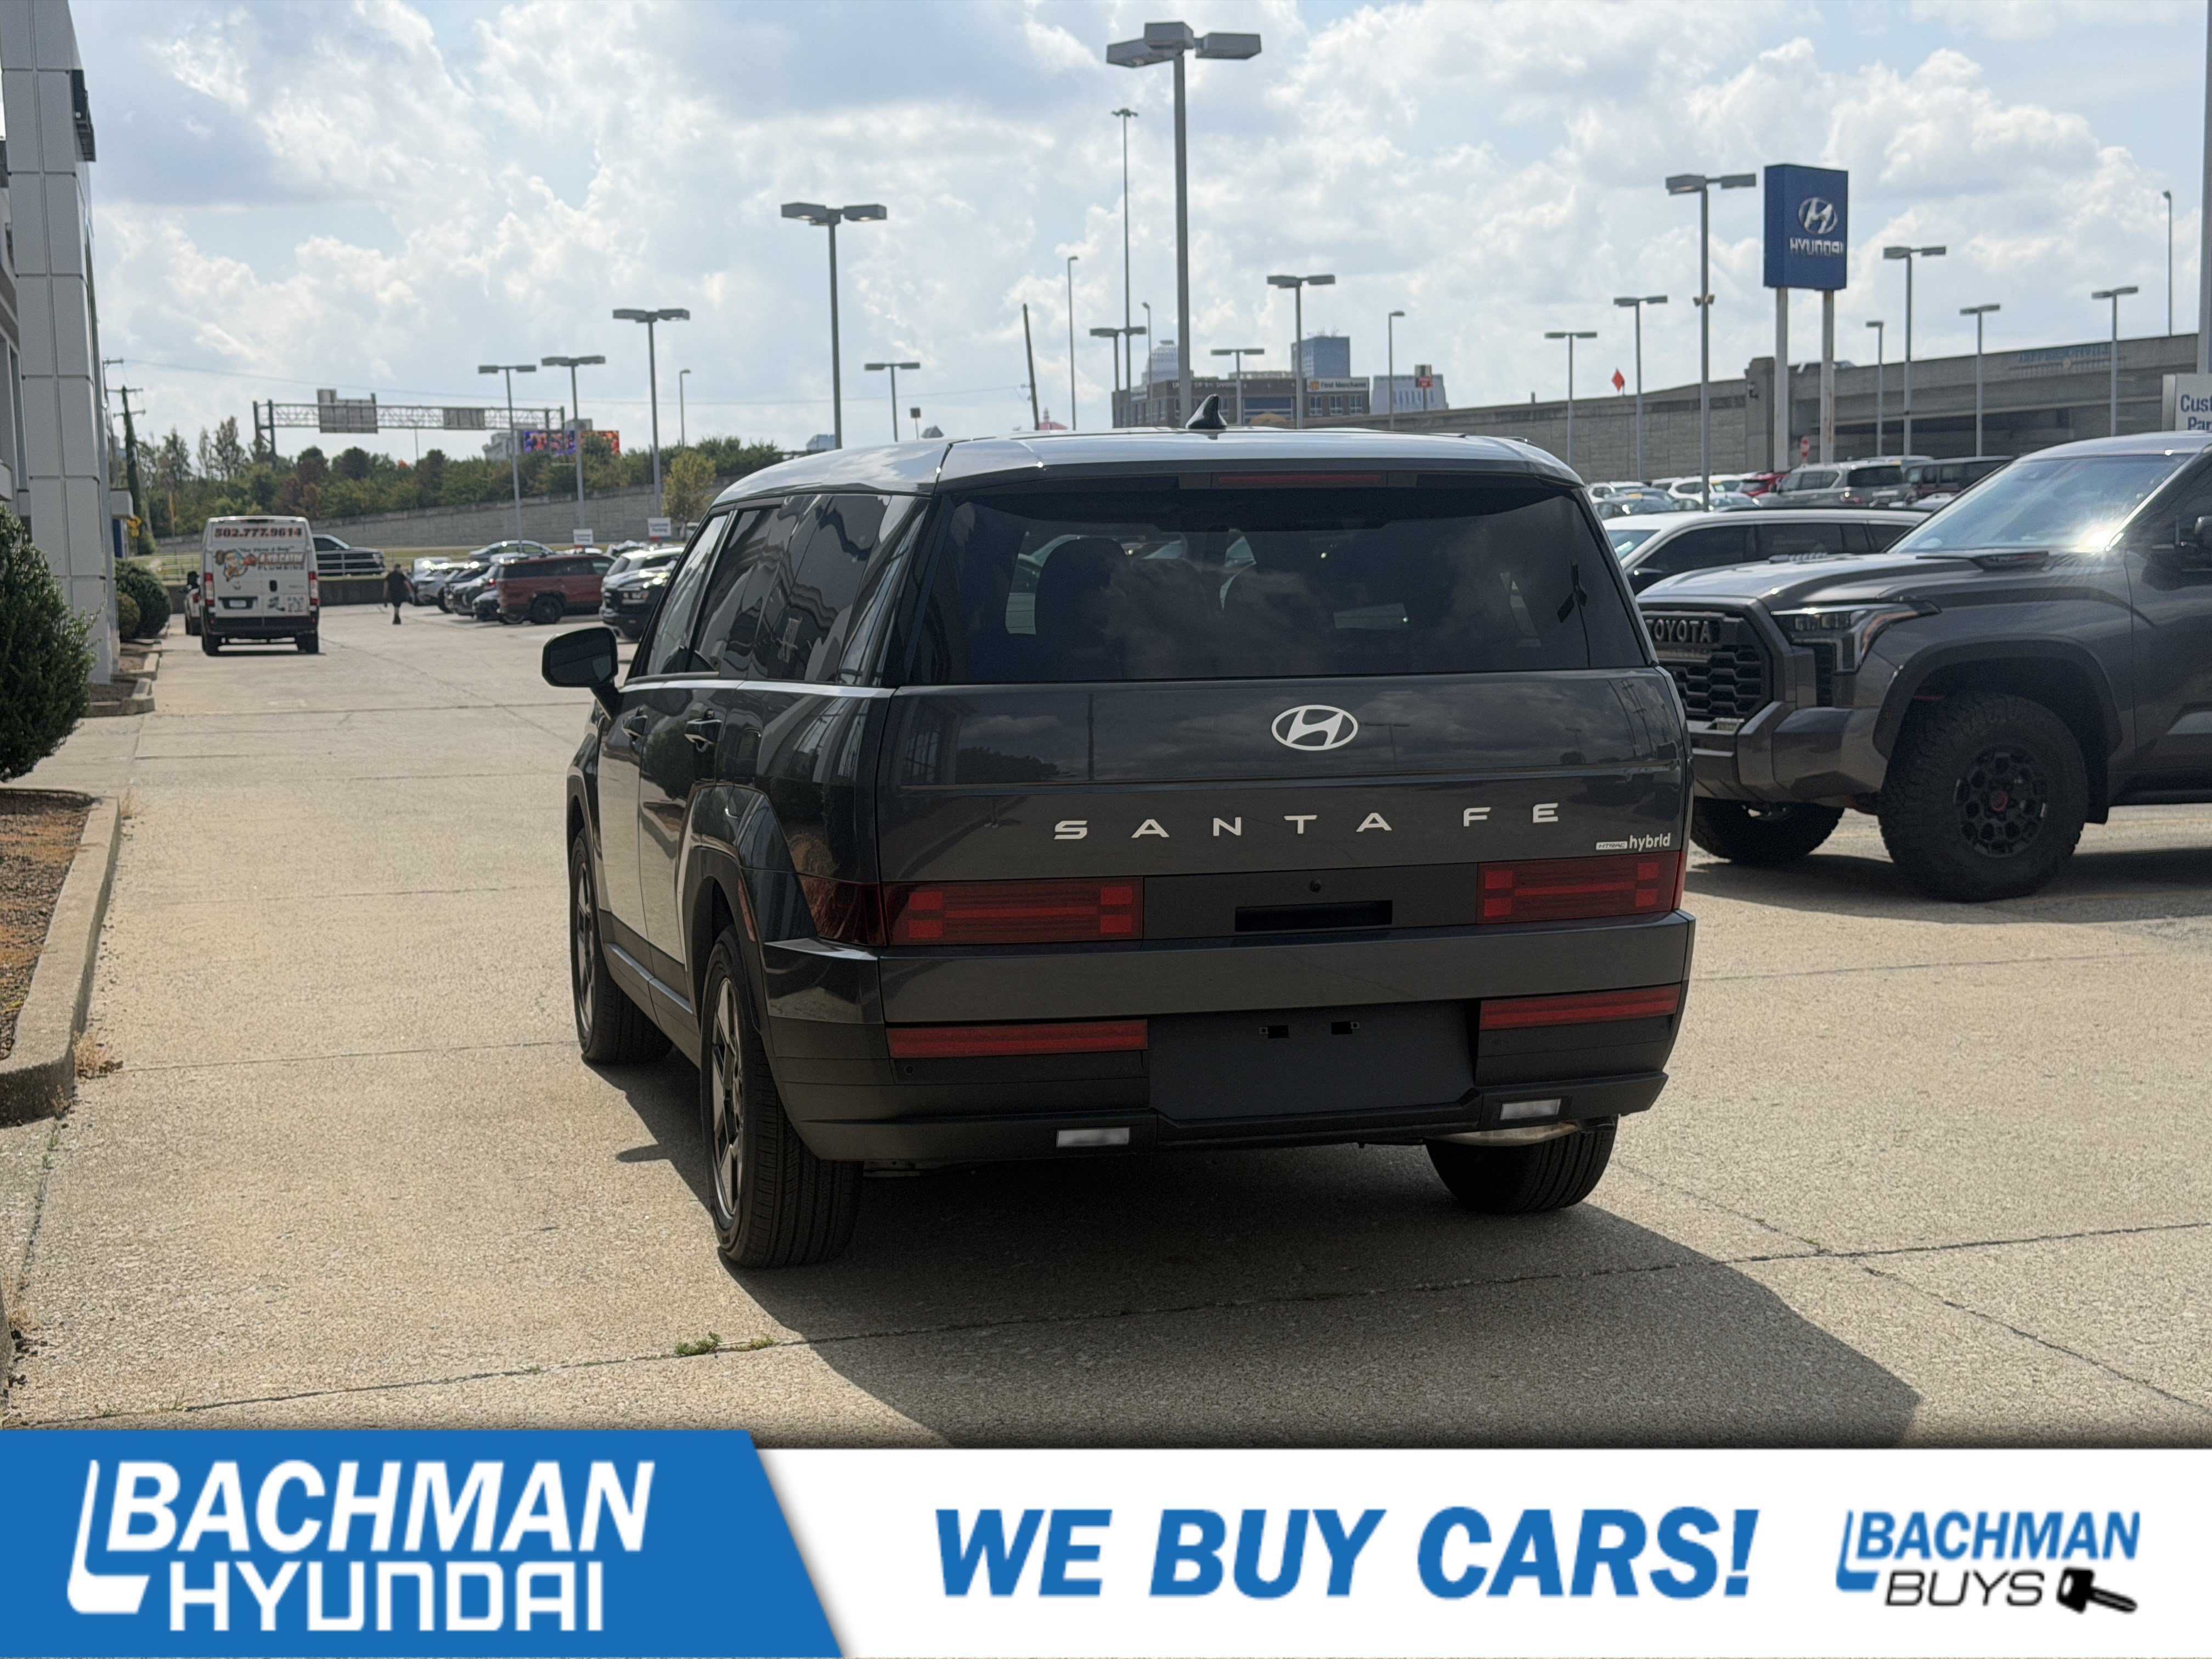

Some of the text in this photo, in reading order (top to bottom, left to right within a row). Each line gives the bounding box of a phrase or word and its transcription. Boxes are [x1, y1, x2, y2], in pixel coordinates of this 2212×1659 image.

[1790, 238, 1844, 256] HYUNDAI
[1645, 619, 1712, 642] TOYOTA
[1054, 803, 1559, 839] SANTA FE
[1629, 832, 1671, 851] hybrid
